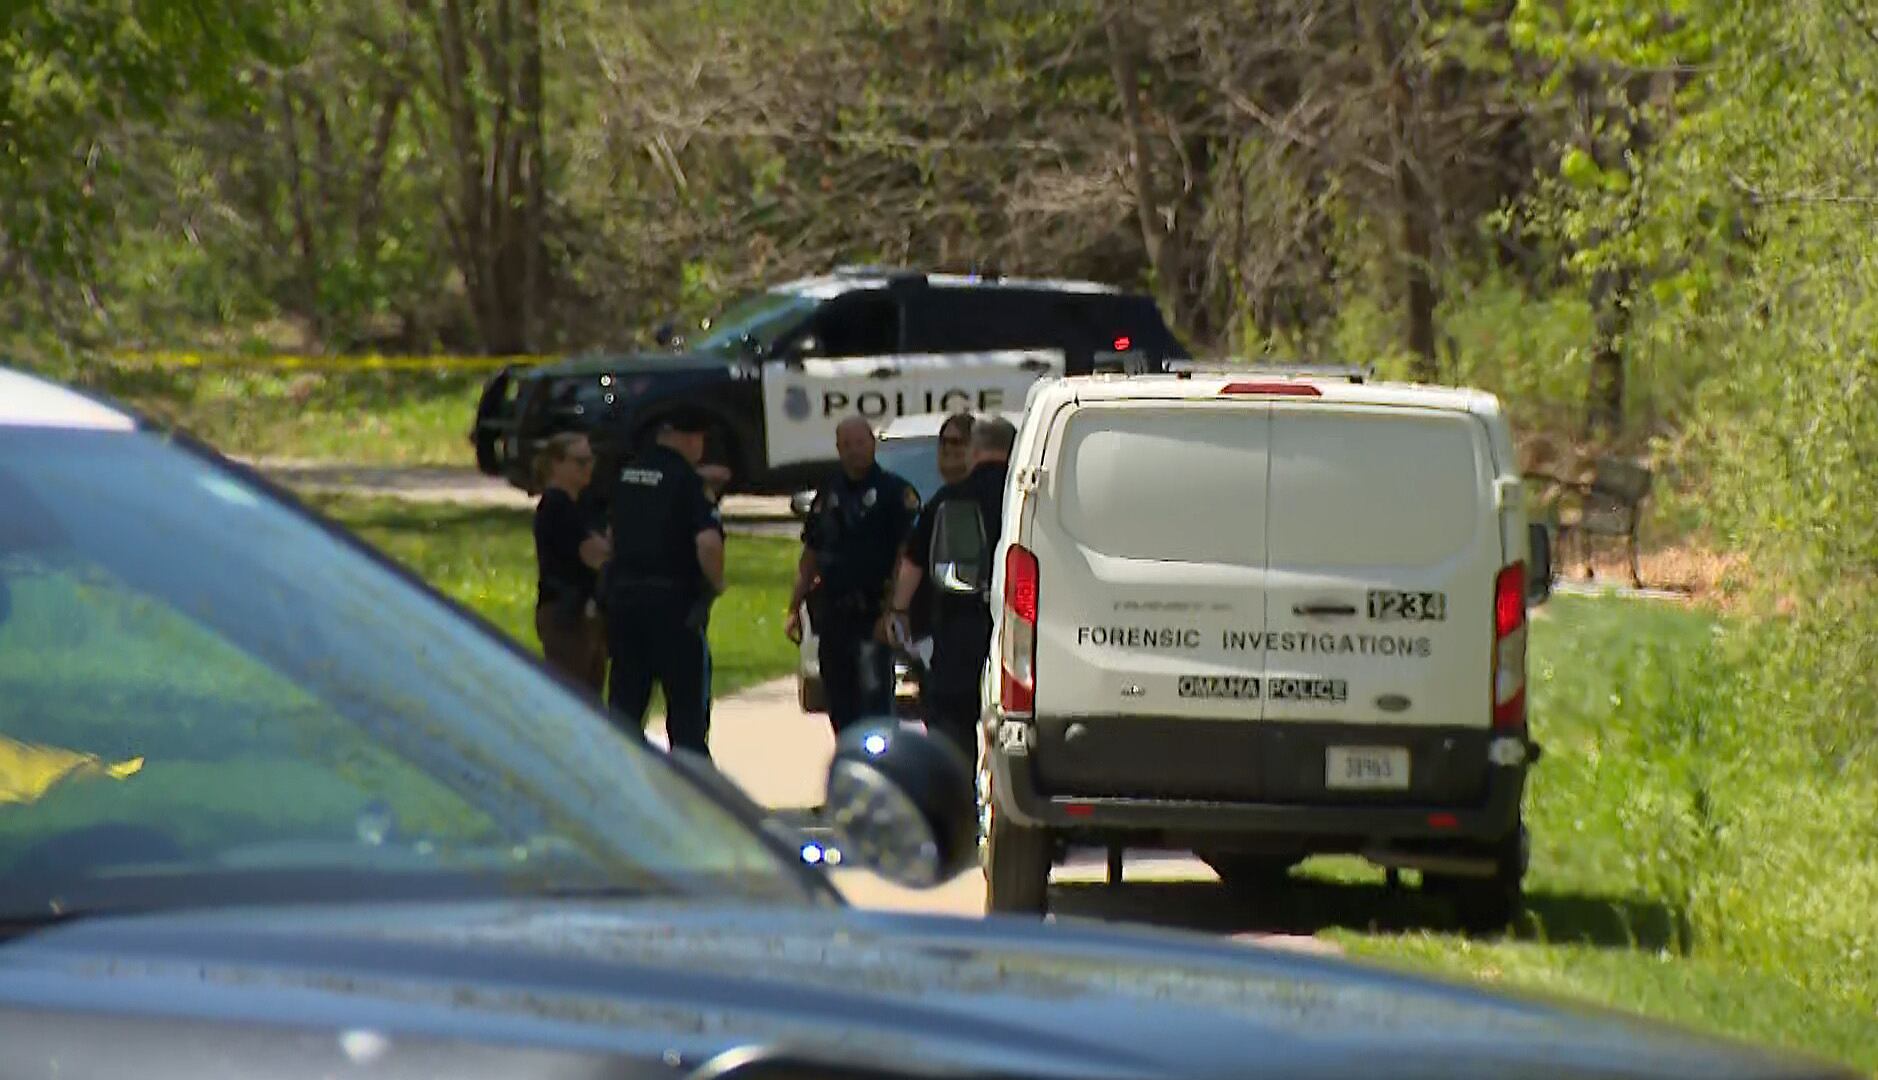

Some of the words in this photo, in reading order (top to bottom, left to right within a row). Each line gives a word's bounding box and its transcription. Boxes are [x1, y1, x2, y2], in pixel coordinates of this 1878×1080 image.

[822, 389, 1003, 418] POLICE
[1077, 627, 1200, 648] FORENSIC
[1223, 630, 1431, 658] INVESTIGATIONS
[1178, 676, 1259, 698] OMAHA
[1268, 679, 1346, 701] POLICE
